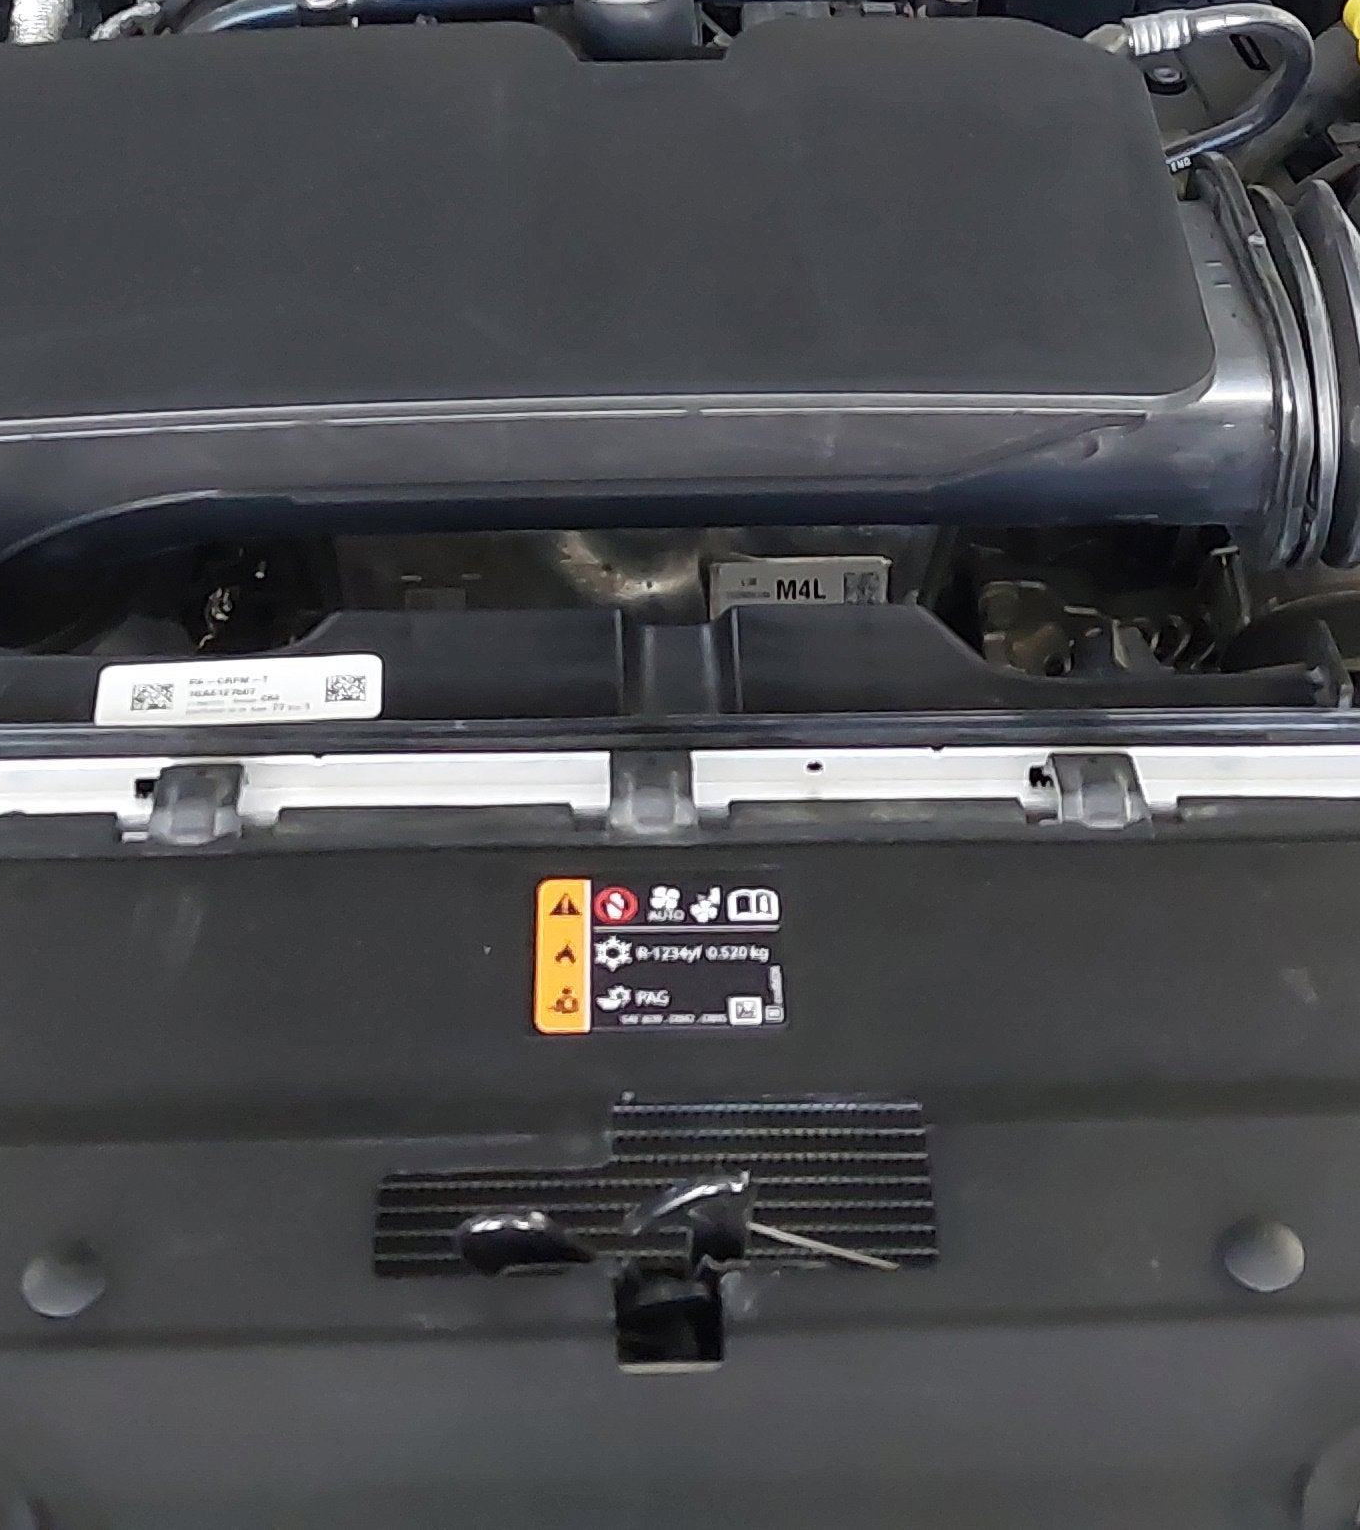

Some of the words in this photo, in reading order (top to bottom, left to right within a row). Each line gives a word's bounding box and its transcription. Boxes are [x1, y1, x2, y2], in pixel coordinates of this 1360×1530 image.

[776, 578, 826, 600] M4L
[646, 910, 685, 922] AUTO
[705, 945, 748, 960] 0.520
[749, 945, 770, 963] kg
[634, 990, 671, 1007] PAG
